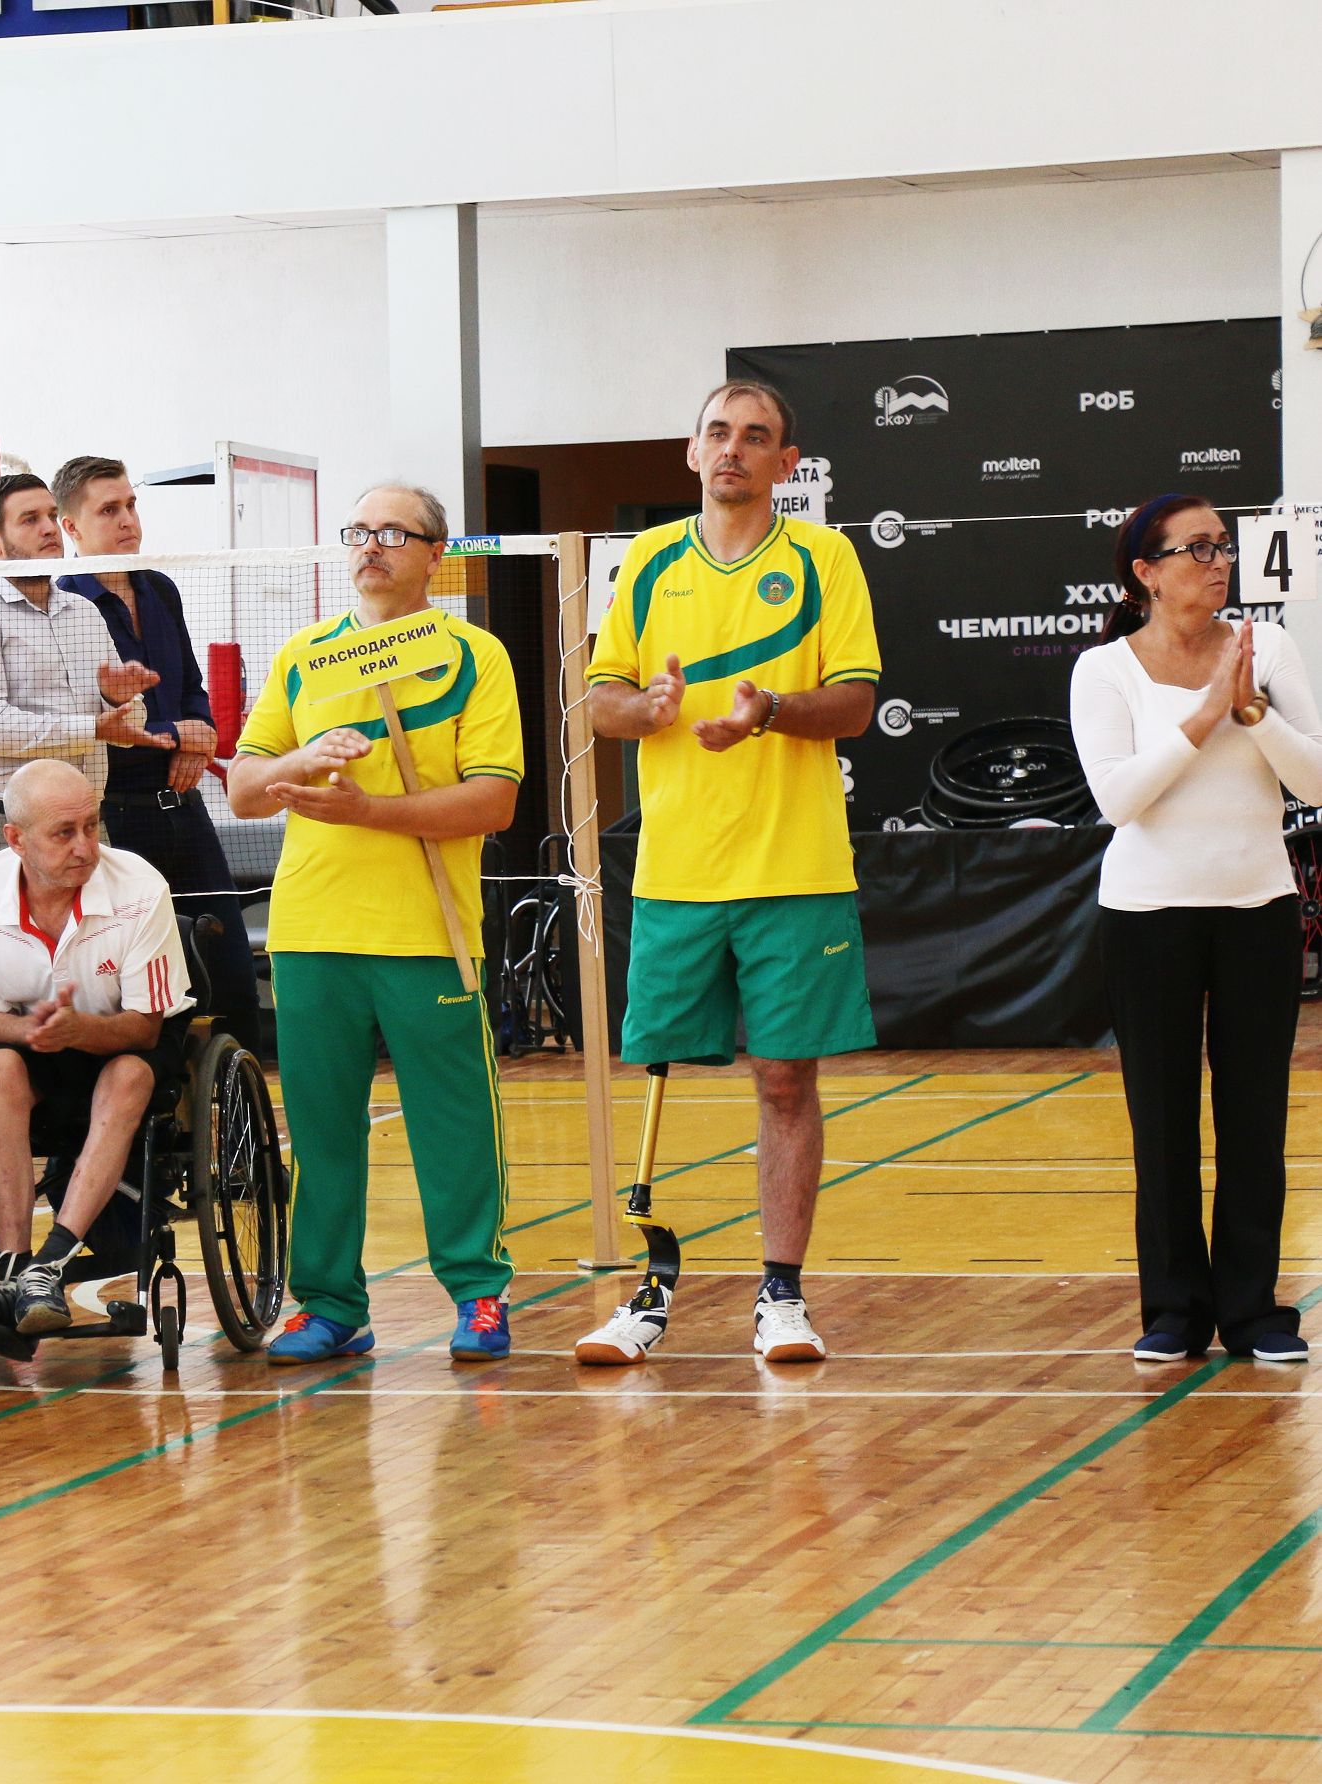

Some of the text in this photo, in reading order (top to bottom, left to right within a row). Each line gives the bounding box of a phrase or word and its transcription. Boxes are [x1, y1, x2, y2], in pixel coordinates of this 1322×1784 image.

[1080, 390, 1135, 412] РФБ
[875, 414, 913, 427] СКФУ
[1181, 448, 1241, 464] molten
[982, 457, 1041, 473] molten
[788, 467, 820, 483] АТА
[457, 538, 497, 552] YONEX
[1264, 531, 1293, 592] 4
[308, 622, 438, 671] КРАСНОДАРСКИЙ
[359, 654, 399, 676] КРАЙ
